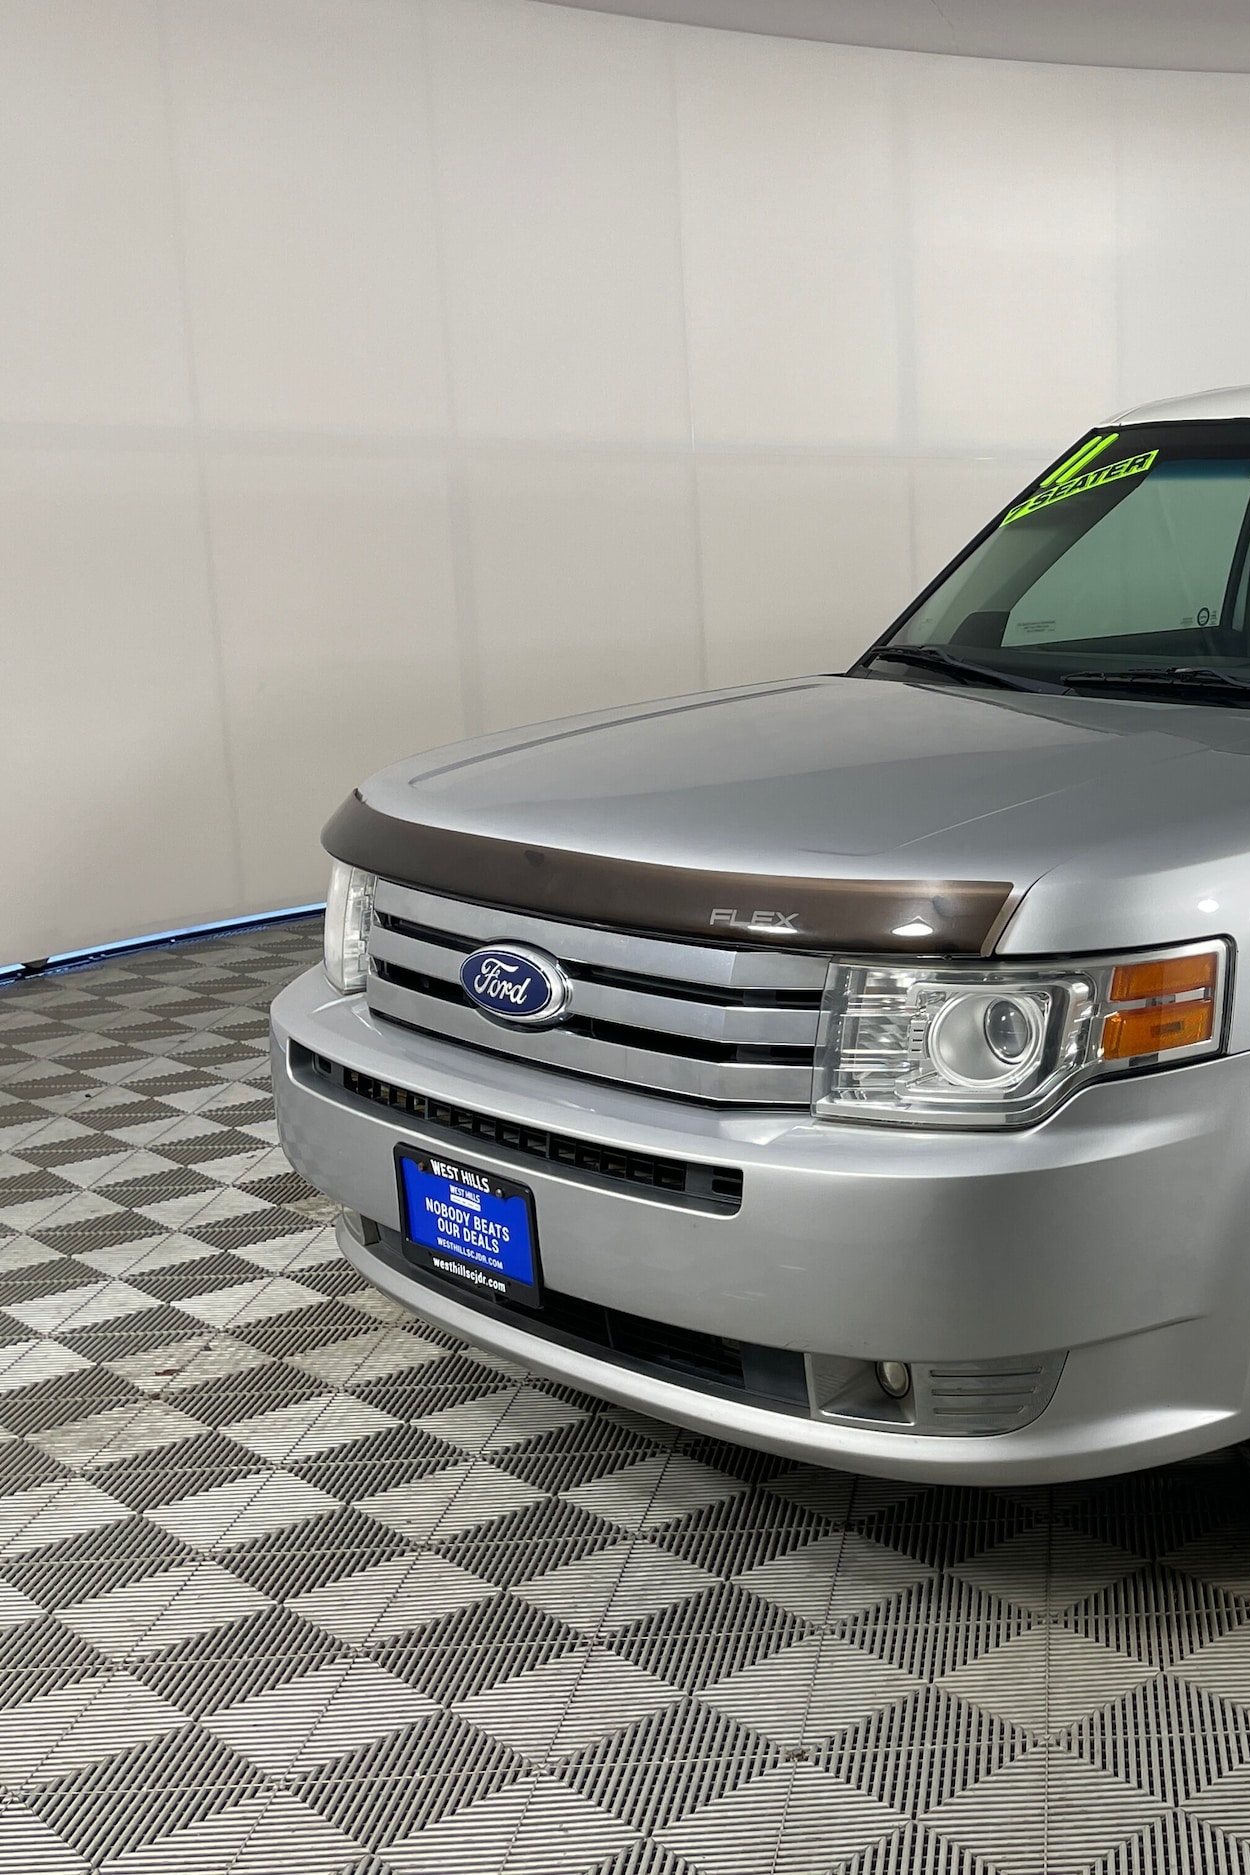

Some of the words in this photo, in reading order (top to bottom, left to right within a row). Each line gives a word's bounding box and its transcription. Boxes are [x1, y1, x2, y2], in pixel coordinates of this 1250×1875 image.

[1003, 500, 1031, 524] 7
[1028, 453, 1152, 511] SEATER
[709, 908, 799, 928] FLEX
[474, 957, 531, 1005] Ford
[430, 1159, 459, 1181] WEST
[460, 1170, 490, 1193] HILLS
[449, 1184, 464, 1197] WEST
[465, 1190, 480, 1203] HILLS
[425, 1197, 471, 1226] NOBODY
[473, 1216, 510, 1242] BEATS
[437, 1217, 460, 1238] OUR
[463, 1228, 499, 1253] DEALS
[436, 1237, 503, 1270] WESTHILLSCJDR.COM
[432, 1257, 506, 1293] westhillscjdr.com
